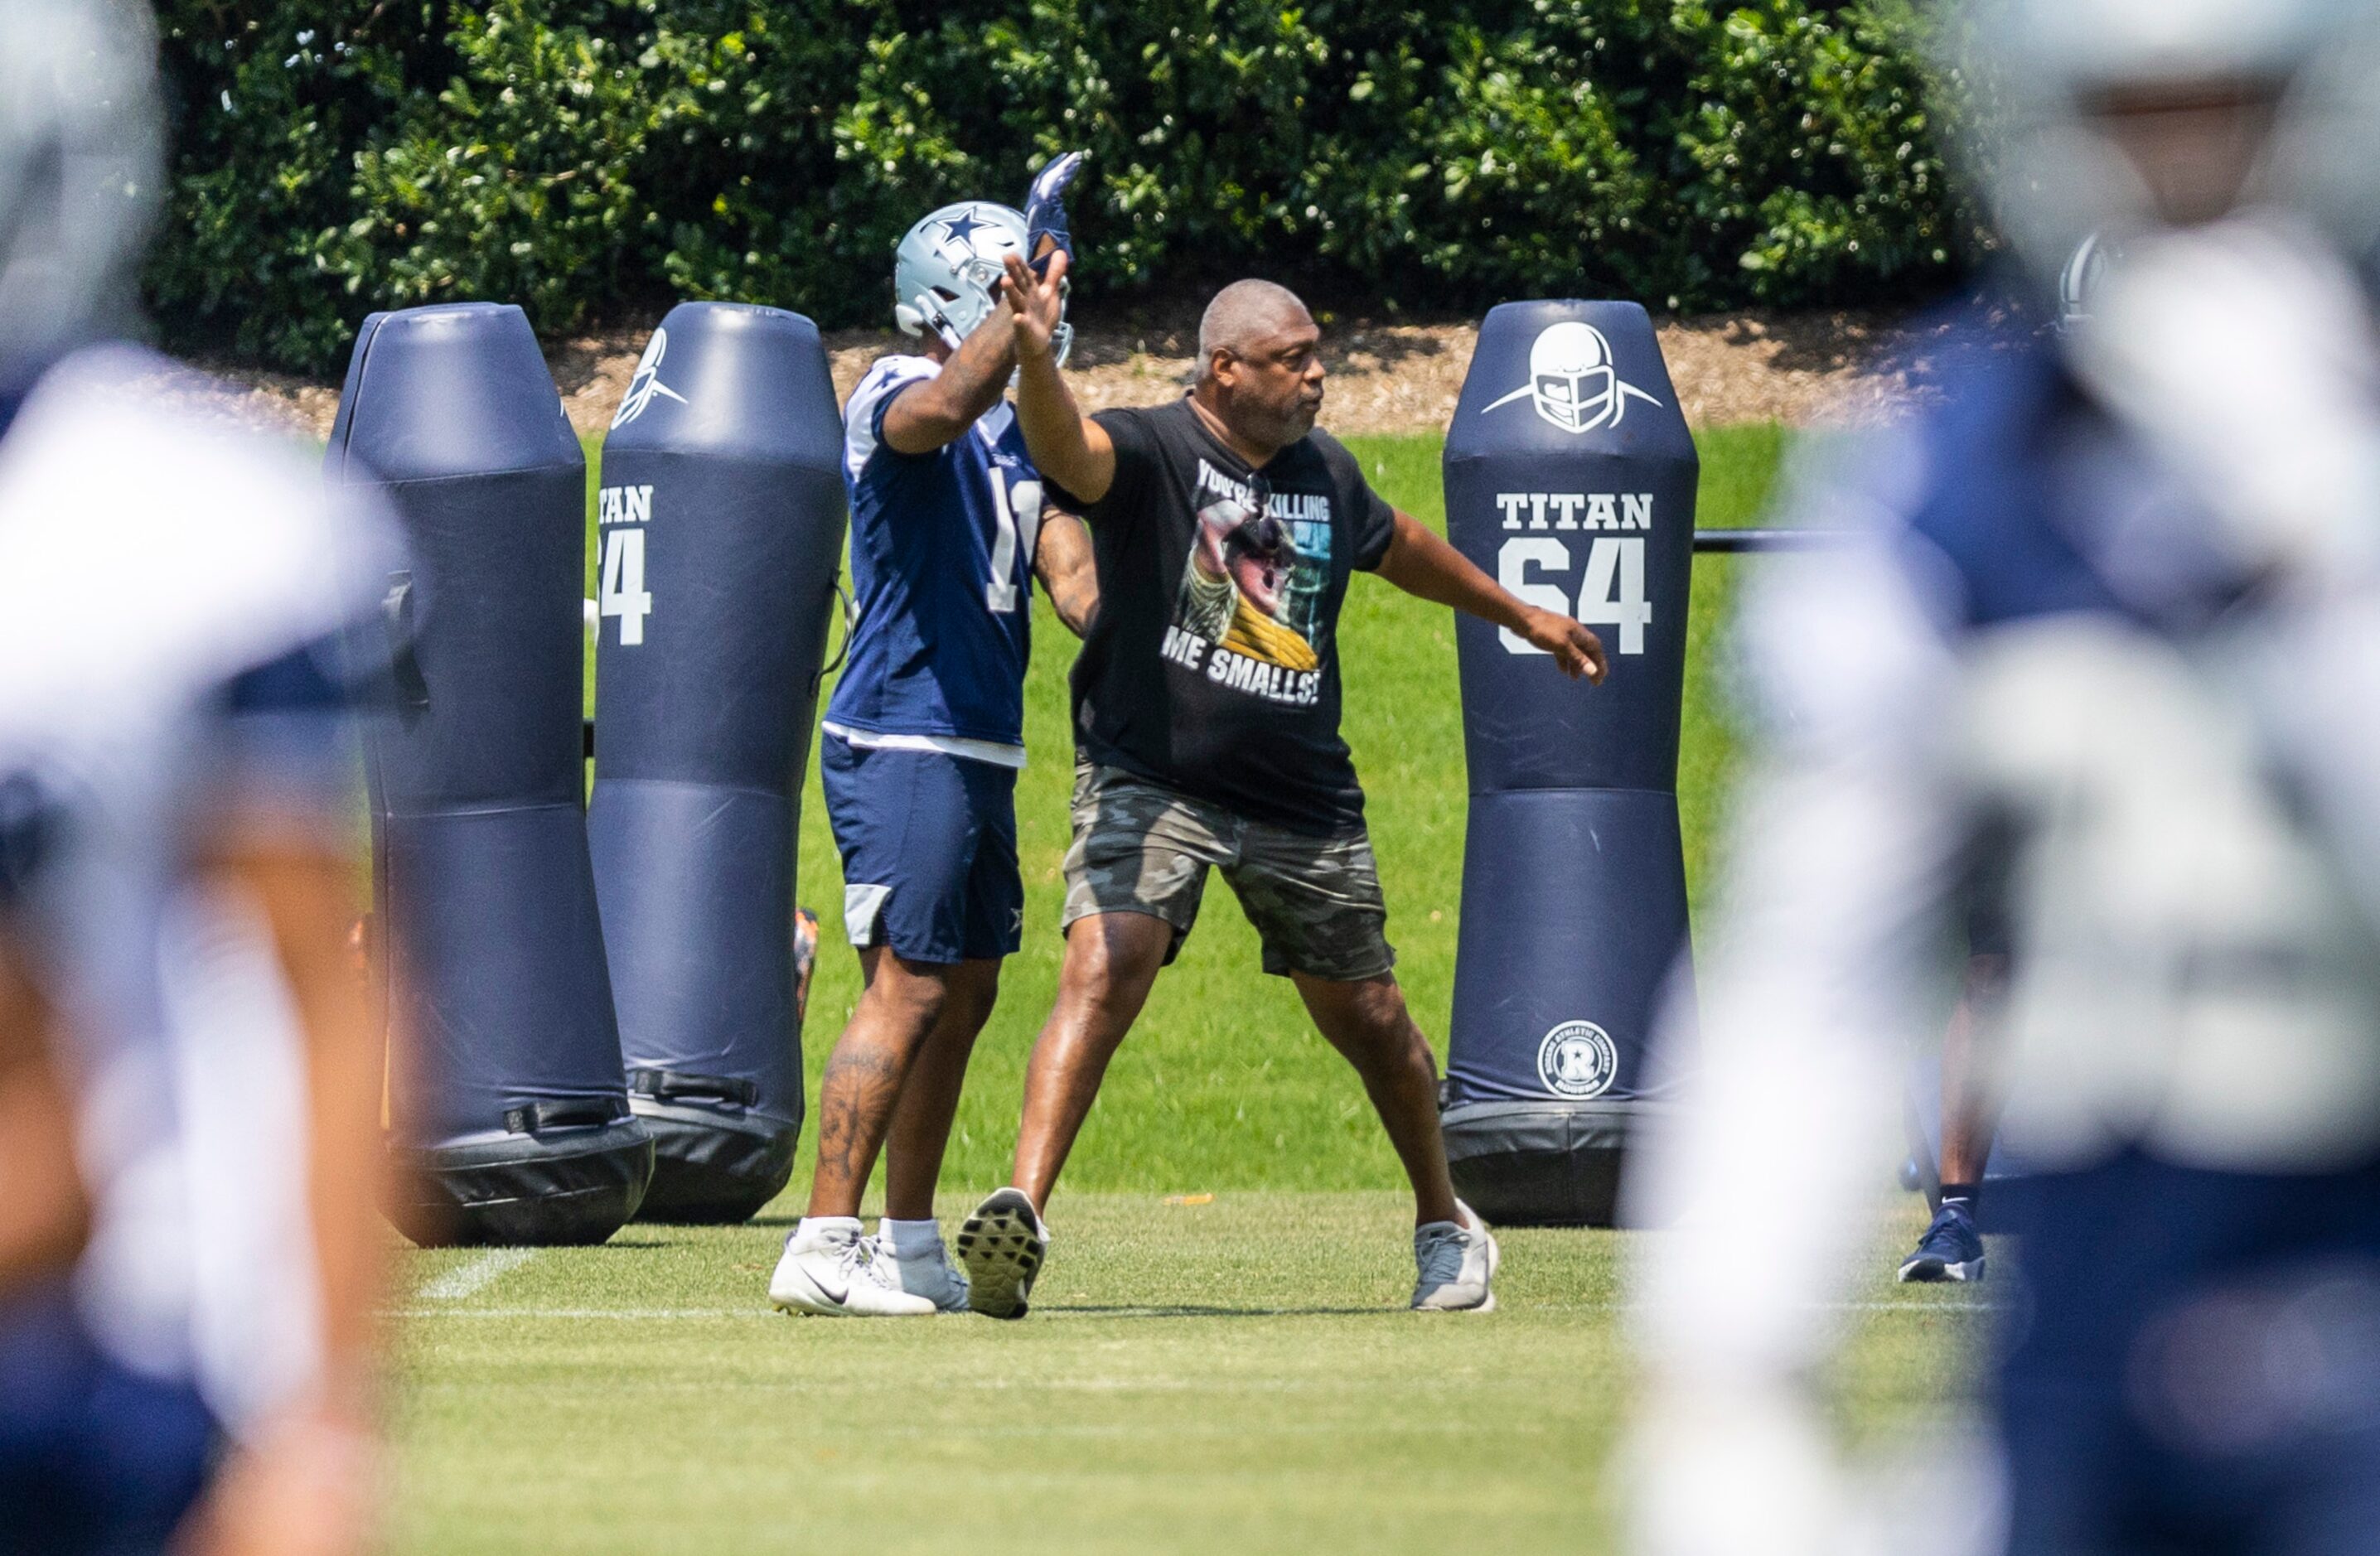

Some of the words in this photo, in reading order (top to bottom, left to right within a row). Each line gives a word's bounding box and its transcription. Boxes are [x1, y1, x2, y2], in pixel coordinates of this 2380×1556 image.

[1269, 493, 1330, 522] KILLING
[1497, 493, 1653, 529] TITAN
[596, 529, 652, 646] 4
[1498, 537, 1652, 655] 64
[1161, 626, 1207, 669] ME
[1207, 648, 1321, 705] SMALLS!
[1555, 1027, 1594, 1042] ATHLETIC
[1561, 1041, 1594, 1080] R
